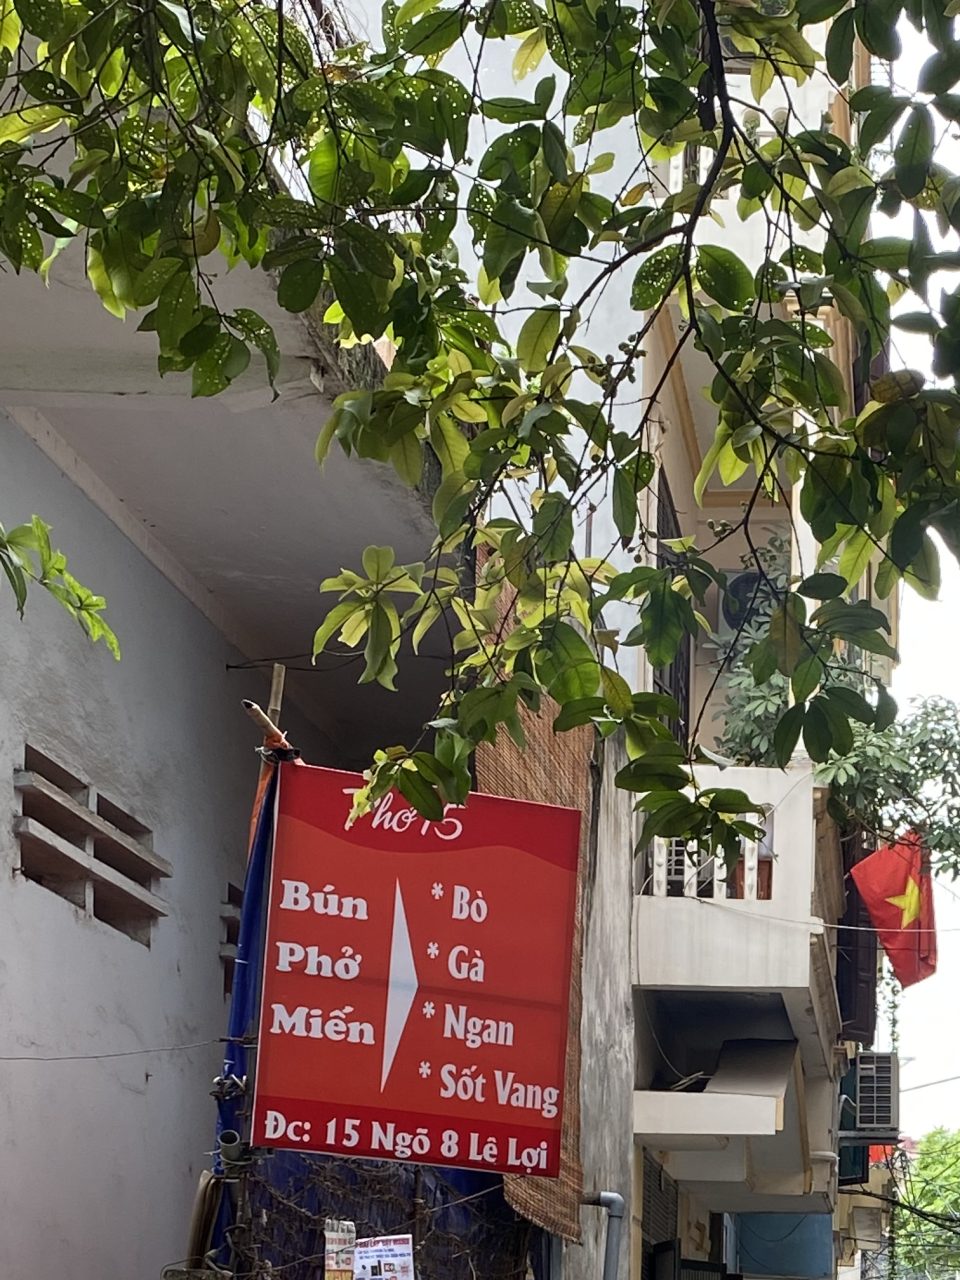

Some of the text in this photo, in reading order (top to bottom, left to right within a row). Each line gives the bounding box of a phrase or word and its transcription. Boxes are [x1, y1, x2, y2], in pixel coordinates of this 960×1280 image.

[279, 879, 369, 920] Bún
[451, 884, 488, 923] Bò
[275, 941, 362, 980] Phở
[447, 944, 485, 982] Gà
[269, 1003, 376, 1045] Miến
[442, 1003, 514, 1049] Ngan
[439, 1063, 560, 1119] Sốt Vang
[264, 1110, 548, 1174] Đc: 15 Ngõ 8 Lê Lợi
